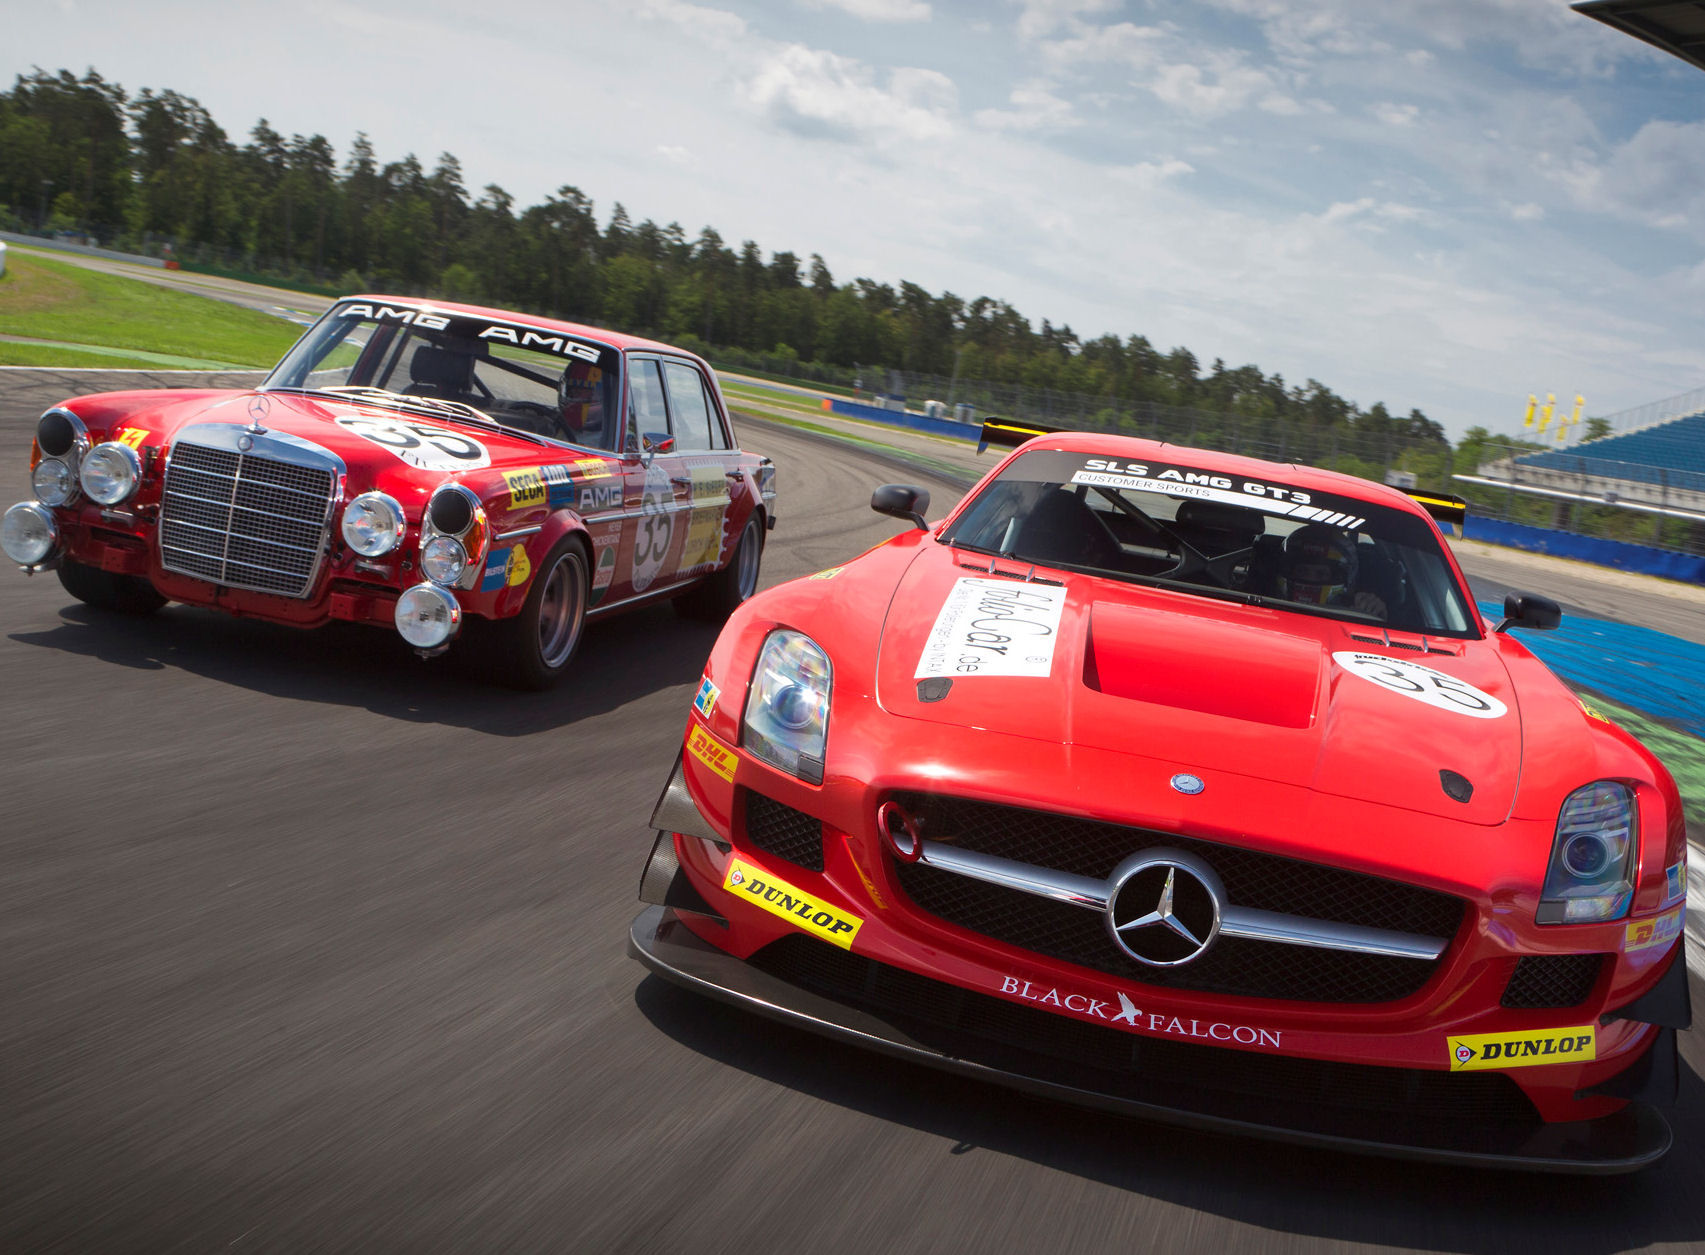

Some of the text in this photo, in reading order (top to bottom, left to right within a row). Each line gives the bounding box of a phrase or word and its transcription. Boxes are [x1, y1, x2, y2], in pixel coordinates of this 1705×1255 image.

[338, 304, 601, 363] AMG AMG
[339, 420, 482, 460] 35
[579, 486, 622, 509] AMG
[1078, 473, 1211, 498] CUSTOMER SPORTS
[1084, 459, 1311, 505] SLS AMG GT3
[634, 492, 674, 566] 35
[1353, 660, 1492, 711] 35
[693, 733, 729, 771] DHL
[746, 878, 854, 934] DUNLOP
[1636, 916, 1678, 945] DHL
[1000, 976, 1282, 1048] BLACK FALCON
[1480, 1035, 1591, 1060] DUNLOP
